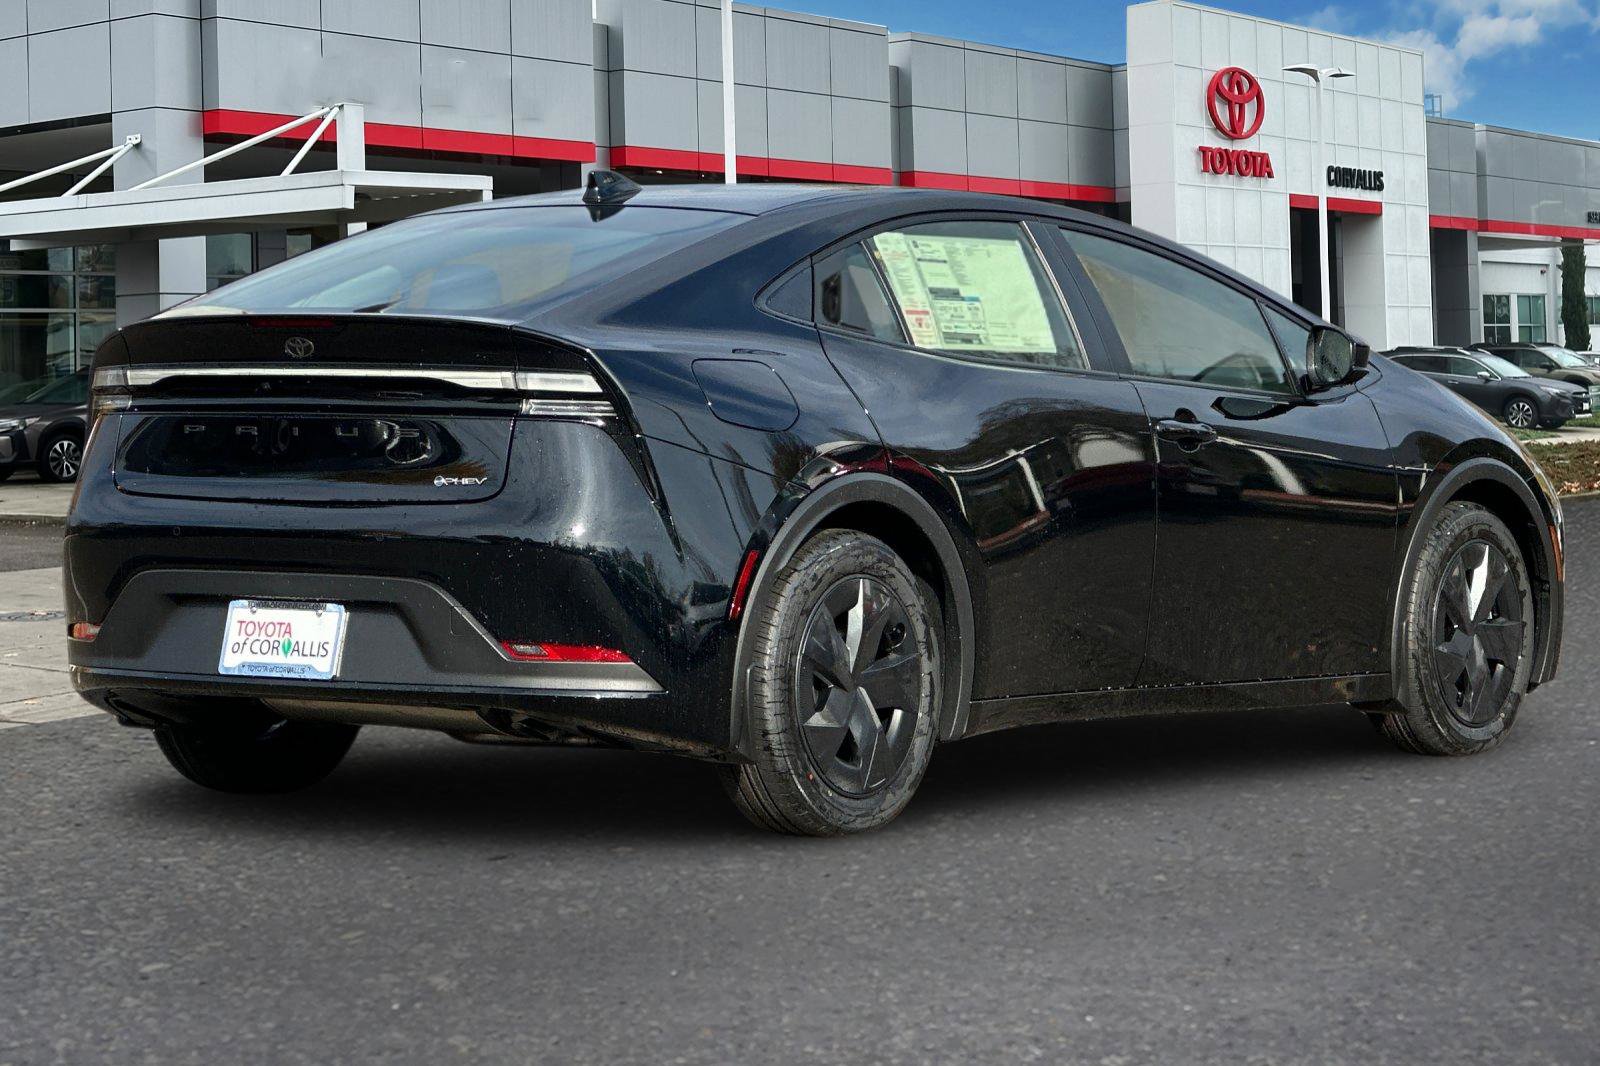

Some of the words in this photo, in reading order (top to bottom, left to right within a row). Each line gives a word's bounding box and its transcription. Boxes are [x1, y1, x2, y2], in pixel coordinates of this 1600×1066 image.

[1199, 146, 1274, 179] TOYOTA
[1327, 165, 1385, 192] CORVALLIS
[237, 620, 292, 638] TOYOTA
[231, 638, 250, 655] of
